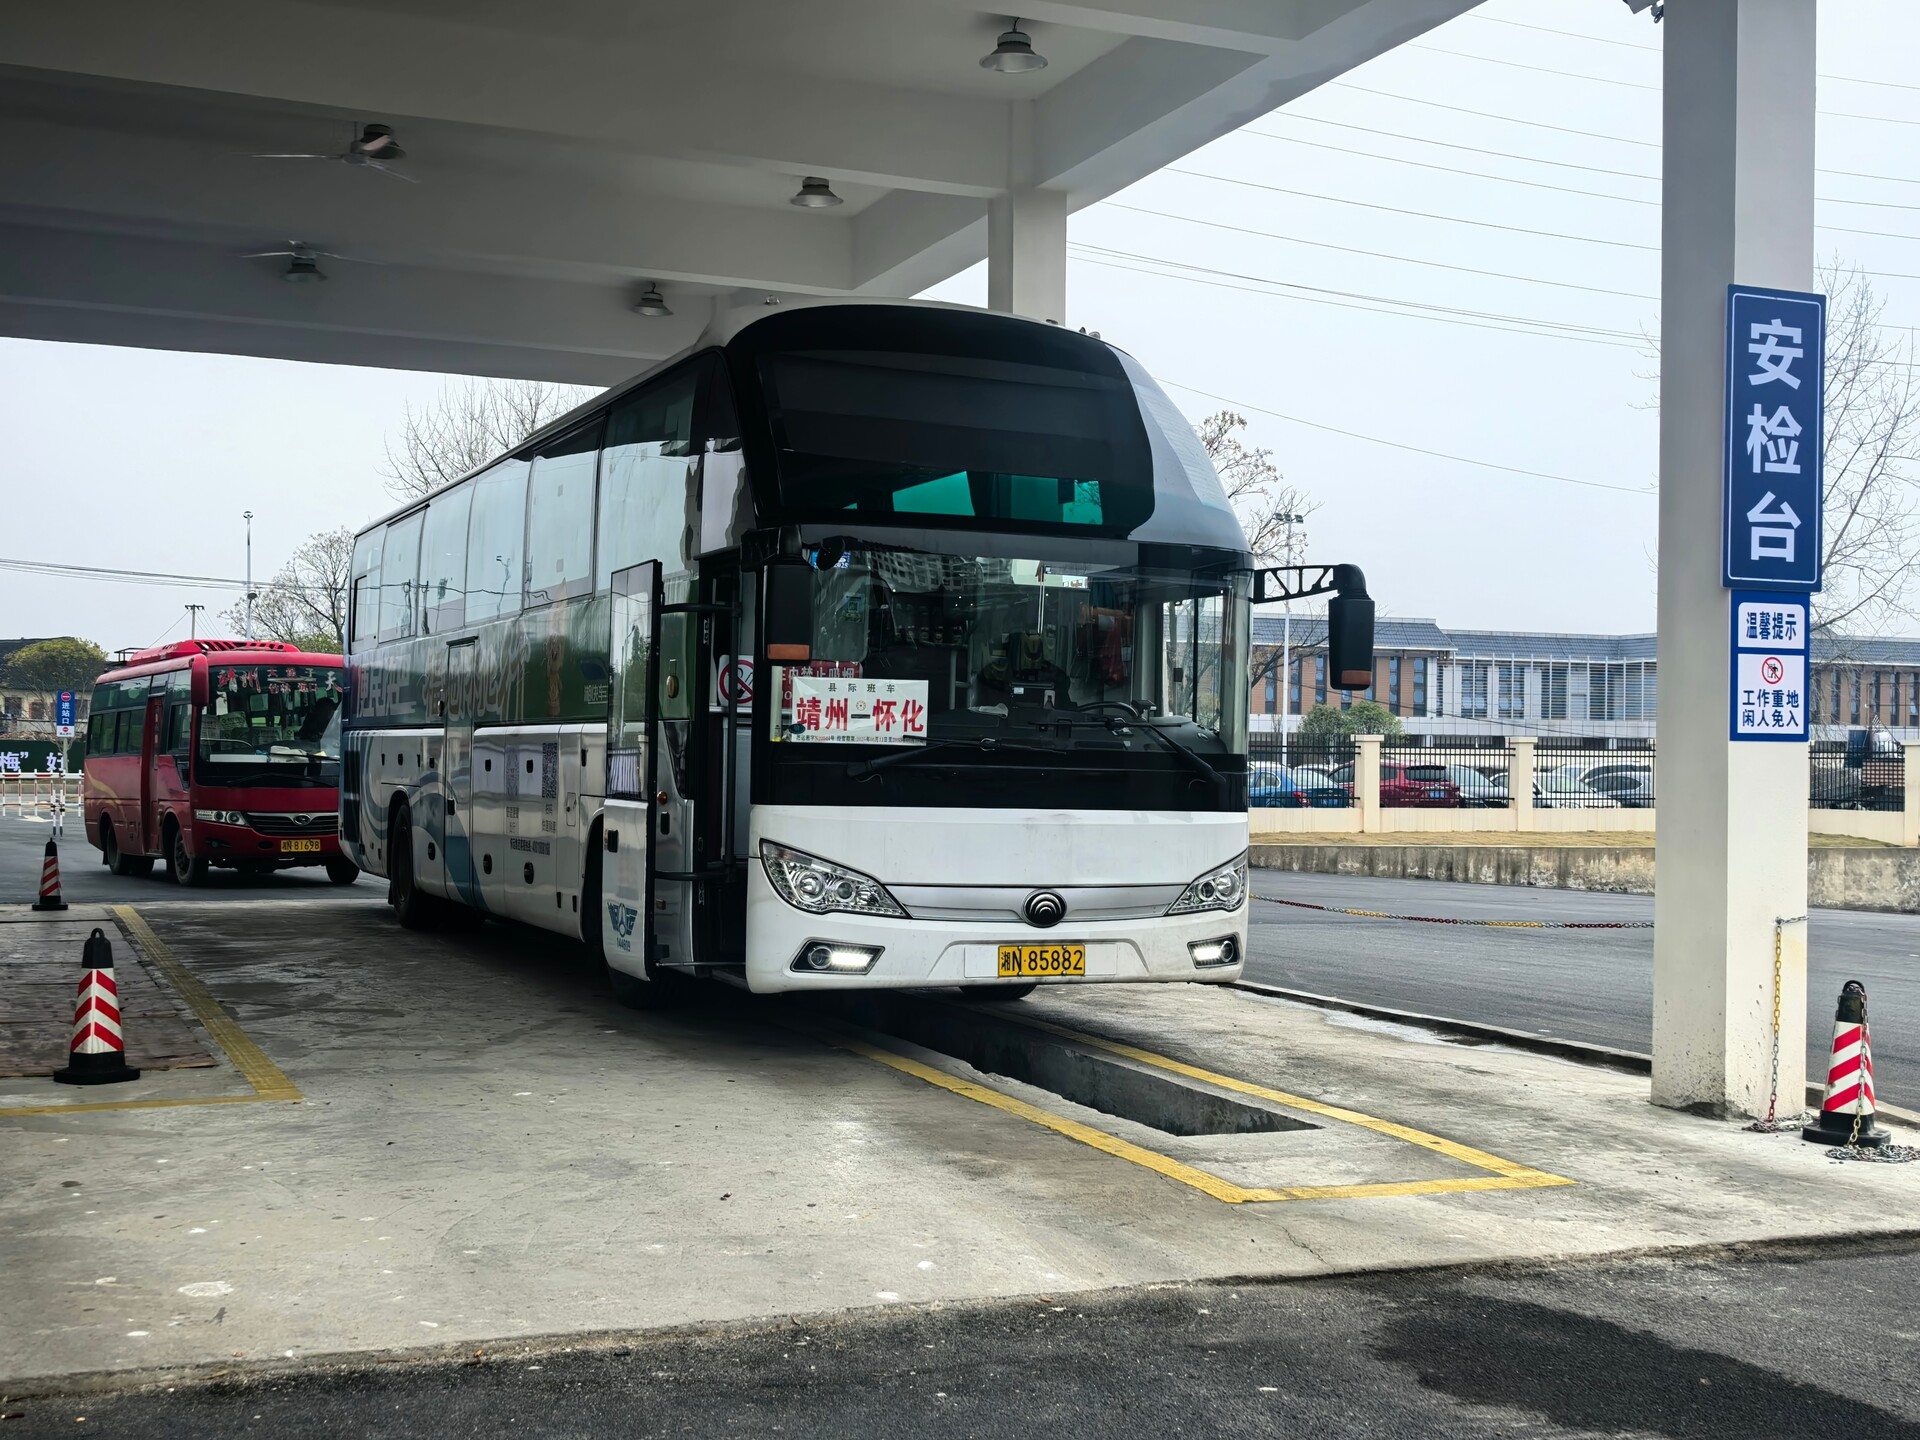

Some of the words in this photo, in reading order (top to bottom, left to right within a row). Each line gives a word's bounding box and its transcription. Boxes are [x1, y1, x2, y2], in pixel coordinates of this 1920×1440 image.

[1747, 318, 1803, 562] 安检台
[1746, 611, 1797, 641] 温馨提示
[828, 682, 895, 693] 县际班车
[1742, 688, 1799, 708] 工作重地
[61, 702, 70, 725] 进站口
[1742, 709, 1799, 727] 闲人免入
